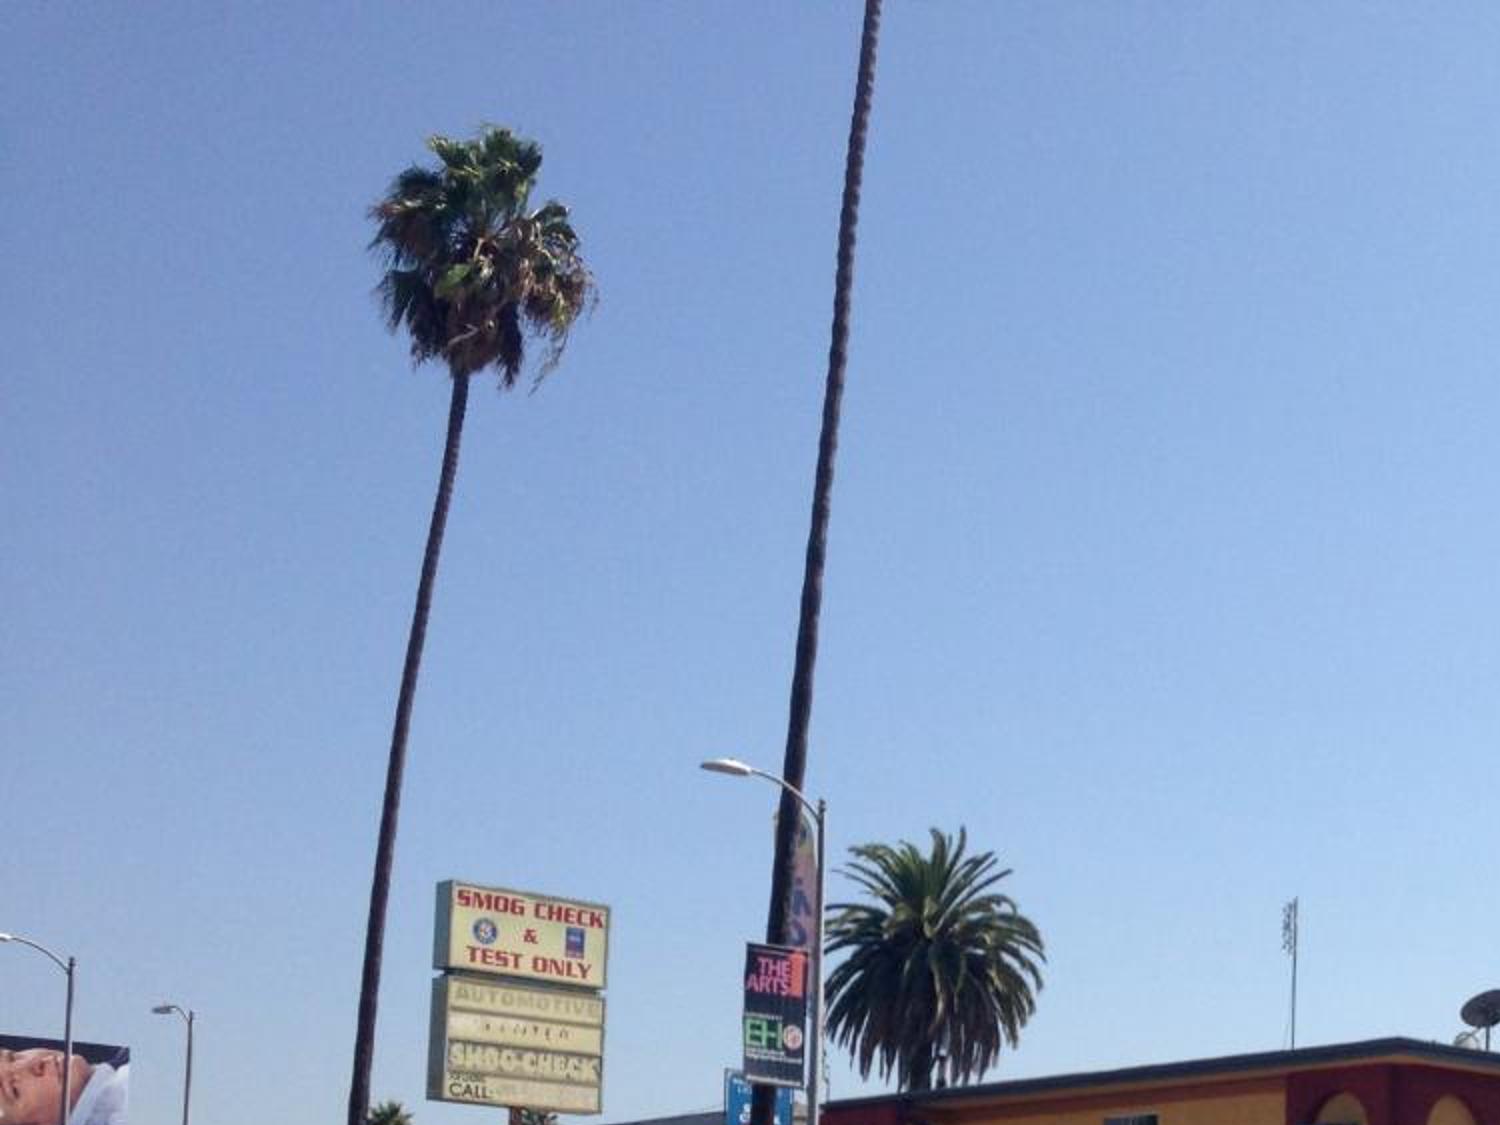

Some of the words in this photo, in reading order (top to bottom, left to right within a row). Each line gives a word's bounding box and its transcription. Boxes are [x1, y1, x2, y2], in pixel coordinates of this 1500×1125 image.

[457, 889, 525, 917] SMOG
[534, 903, 604, 929] CHECK
[523, 928, 539, 945] &
[466, 946, 523, 969] TEST
[532, 958, 593, 979] ONLY
[758, 956, 791, 977] THE
[746, 975, 791, 996] ARTS
